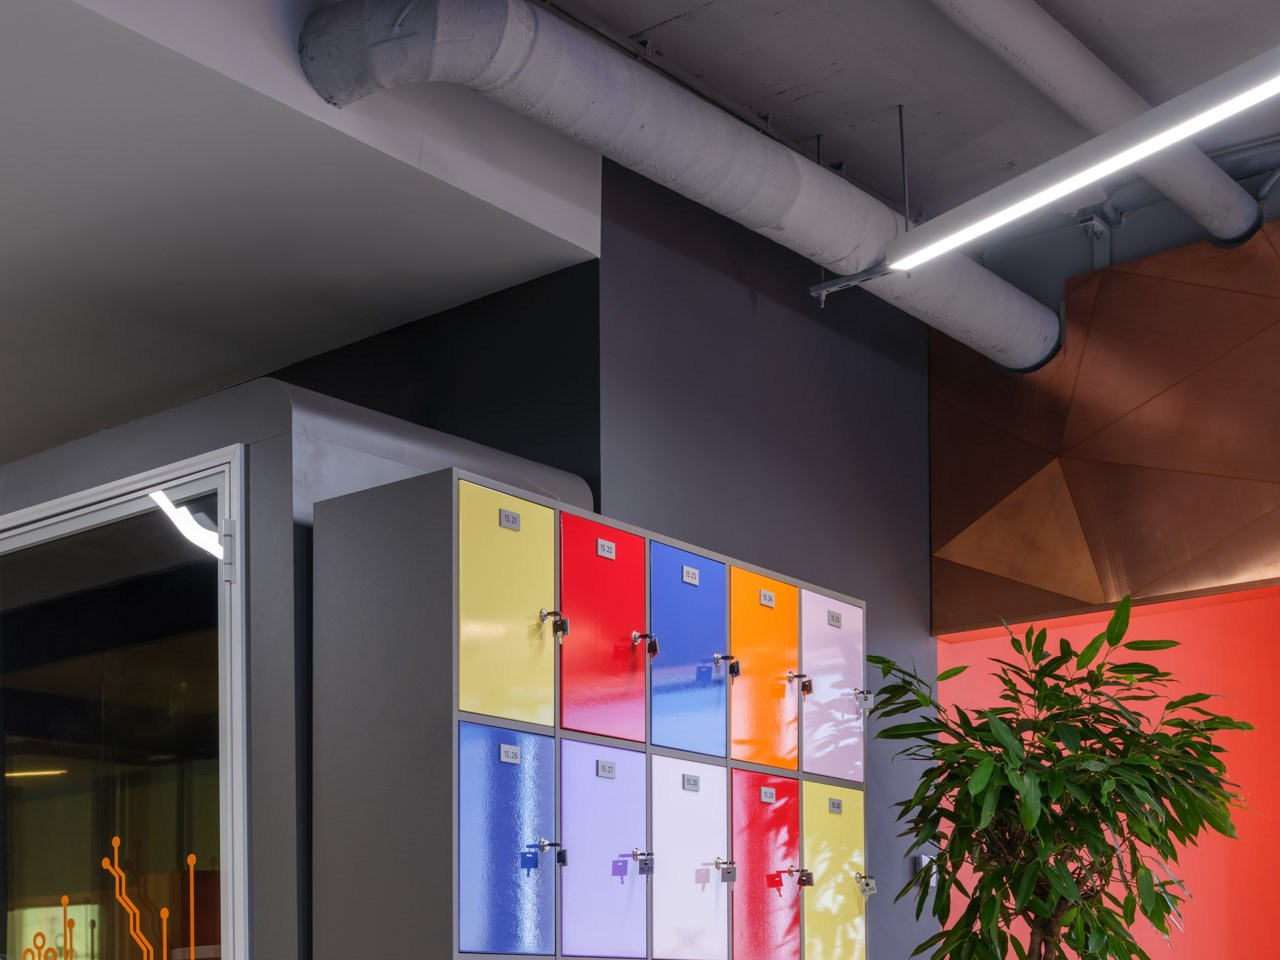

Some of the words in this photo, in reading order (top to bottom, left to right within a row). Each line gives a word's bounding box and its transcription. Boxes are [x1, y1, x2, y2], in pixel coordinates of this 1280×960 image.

[504, 513, 517, 525] 15.21
[600, 543, 613, 554] 15.22
[685, 570, 697, 580] 15.23
[504, 750, 518, 760] 15.26
[601, 764, 613, 774] 15.27
